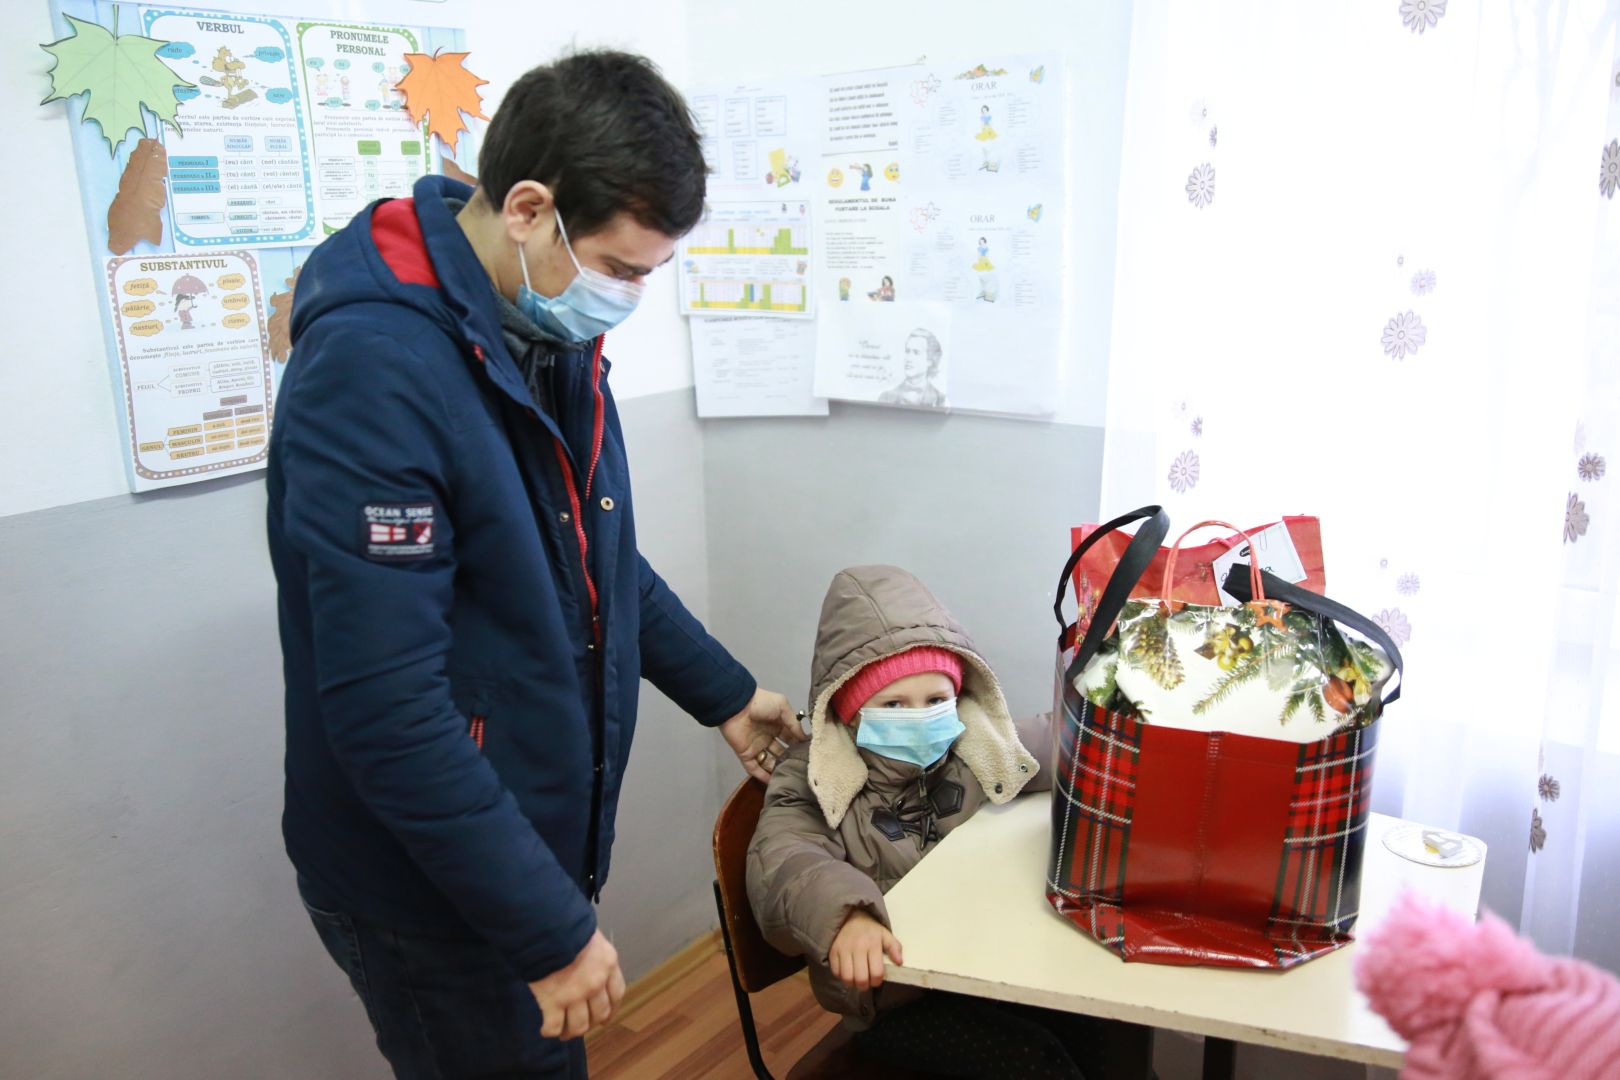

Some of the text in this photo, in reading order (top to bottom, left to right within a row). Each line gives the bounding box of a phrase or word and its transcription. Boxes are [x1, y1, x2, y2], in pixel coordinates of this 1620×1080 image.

[196, 21, 245, 34] VERBUL
[330, 30, 390, 44] PRONUMELE
[336, 44, 386, 56] PERSONAL
[971, 81, 997, 92] ORAR
[970, 214, 995, 224] ORAR
[140, 259, 228, 272] SUBSTANTIVUL
[364, 505, 401, 517] OCEAN
